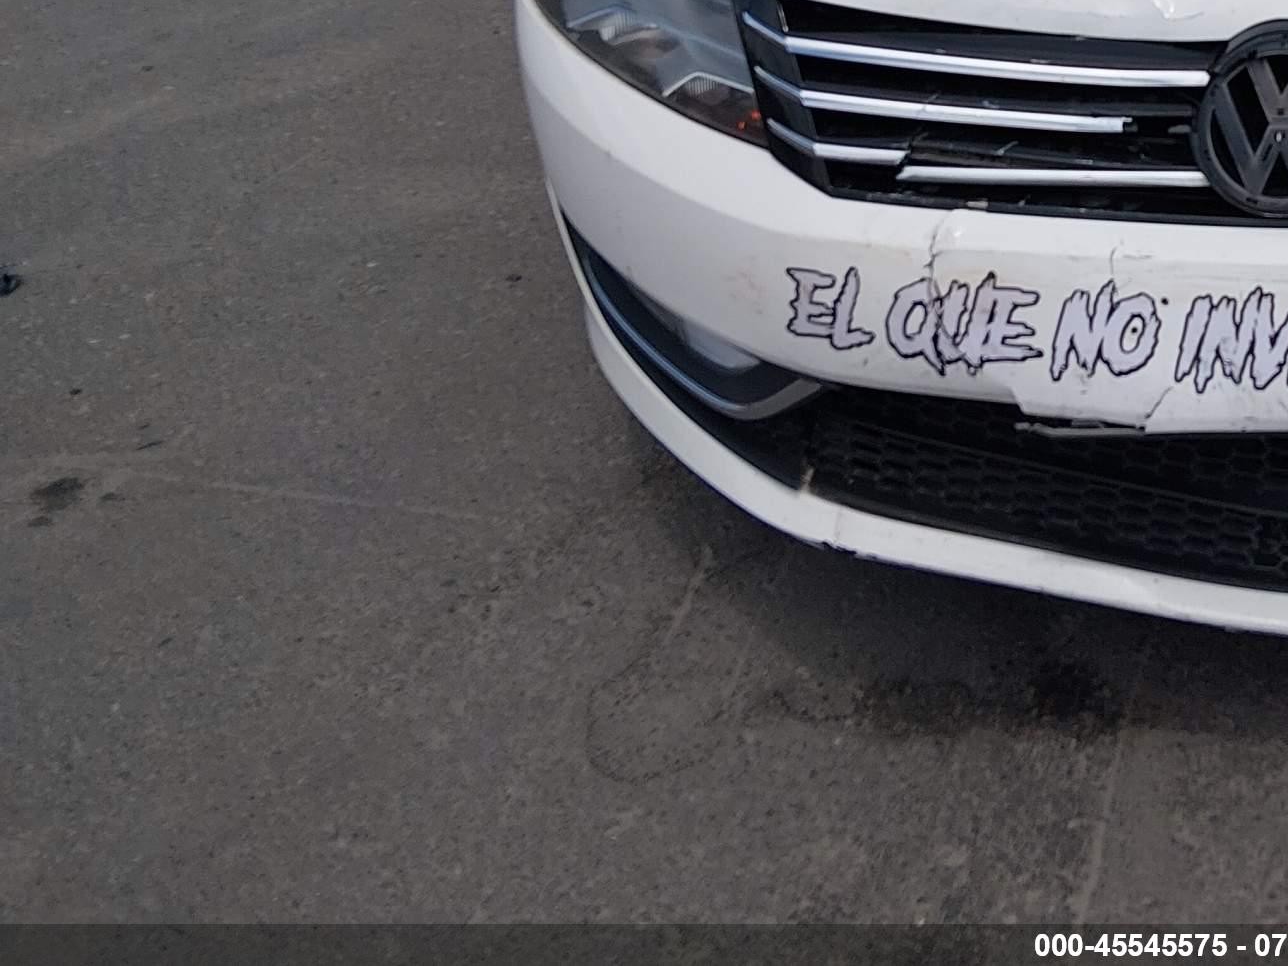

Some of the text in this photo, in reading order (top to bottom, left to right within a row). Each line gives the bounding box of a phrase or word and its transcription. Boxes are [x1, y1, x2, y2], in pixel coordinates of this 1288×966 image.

[786, 267, 874, 349] EL
[885, 272, 1044, 376] QUE
[1051, 280, 1163, 381] NO
